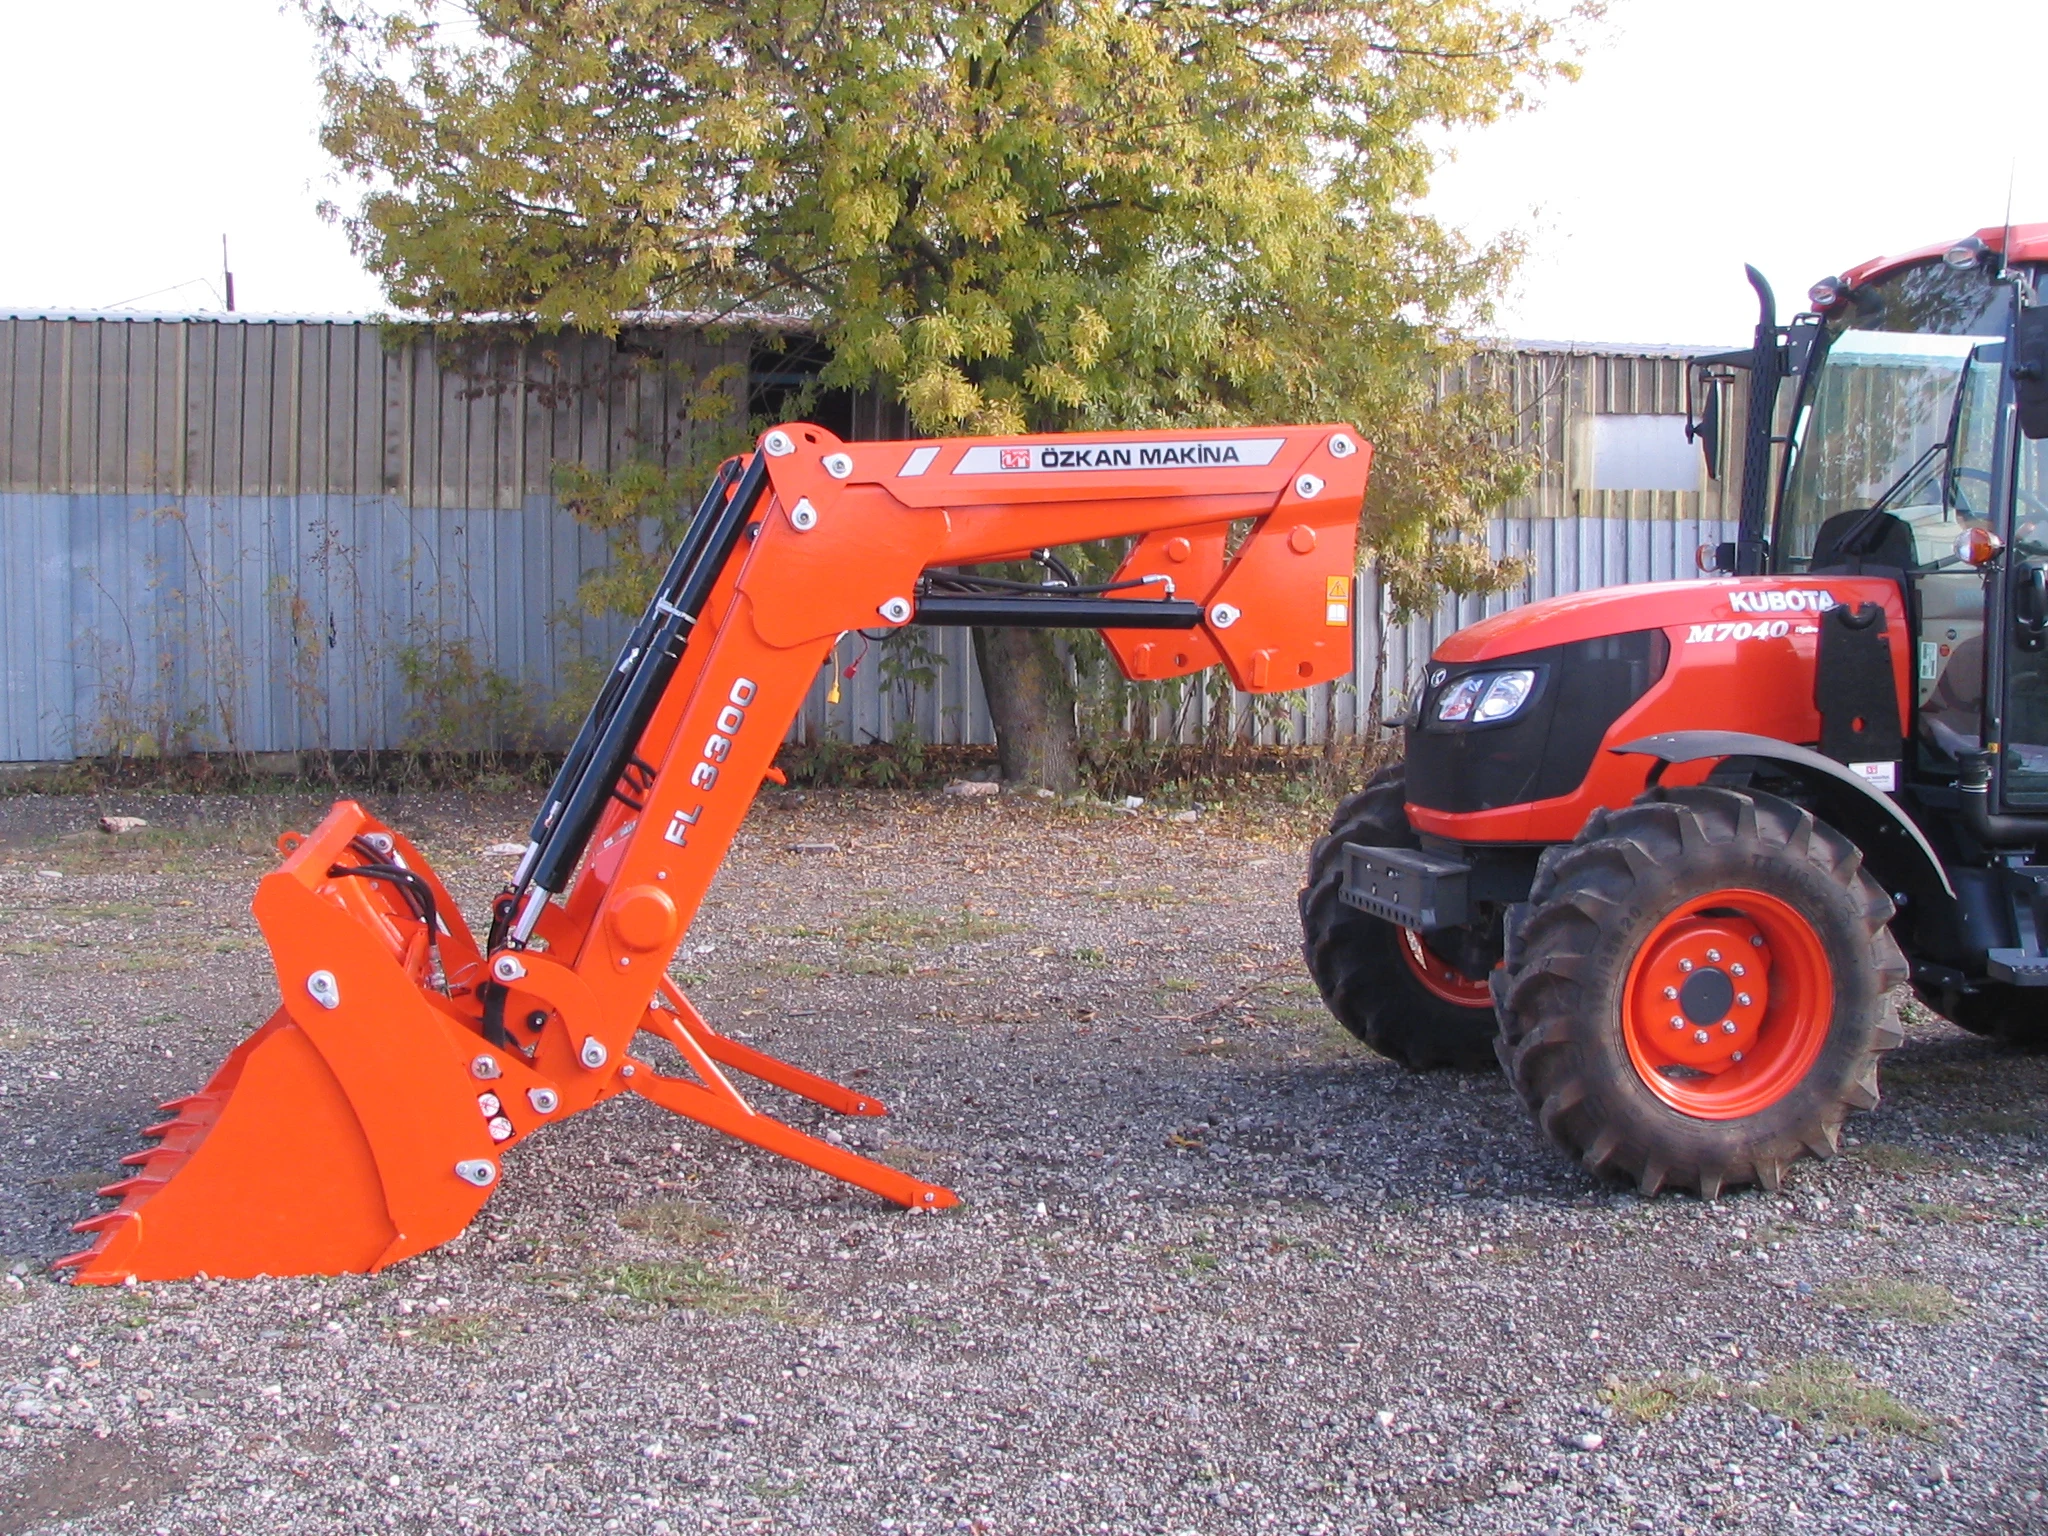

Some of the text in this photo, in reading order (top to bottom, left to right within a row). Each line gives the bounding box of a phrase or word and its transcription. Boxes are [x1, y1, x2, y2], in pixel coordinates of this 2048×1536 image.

[1041, 448, 1131, 468] ÖZKAN
[1140, 444, 1240, 465] MAKİNA
[1728, 589, 1836, 612] KUBOTA
[1685, 620, 1789, 643] M7040
[663, 677, 758, 848] FL 3300
